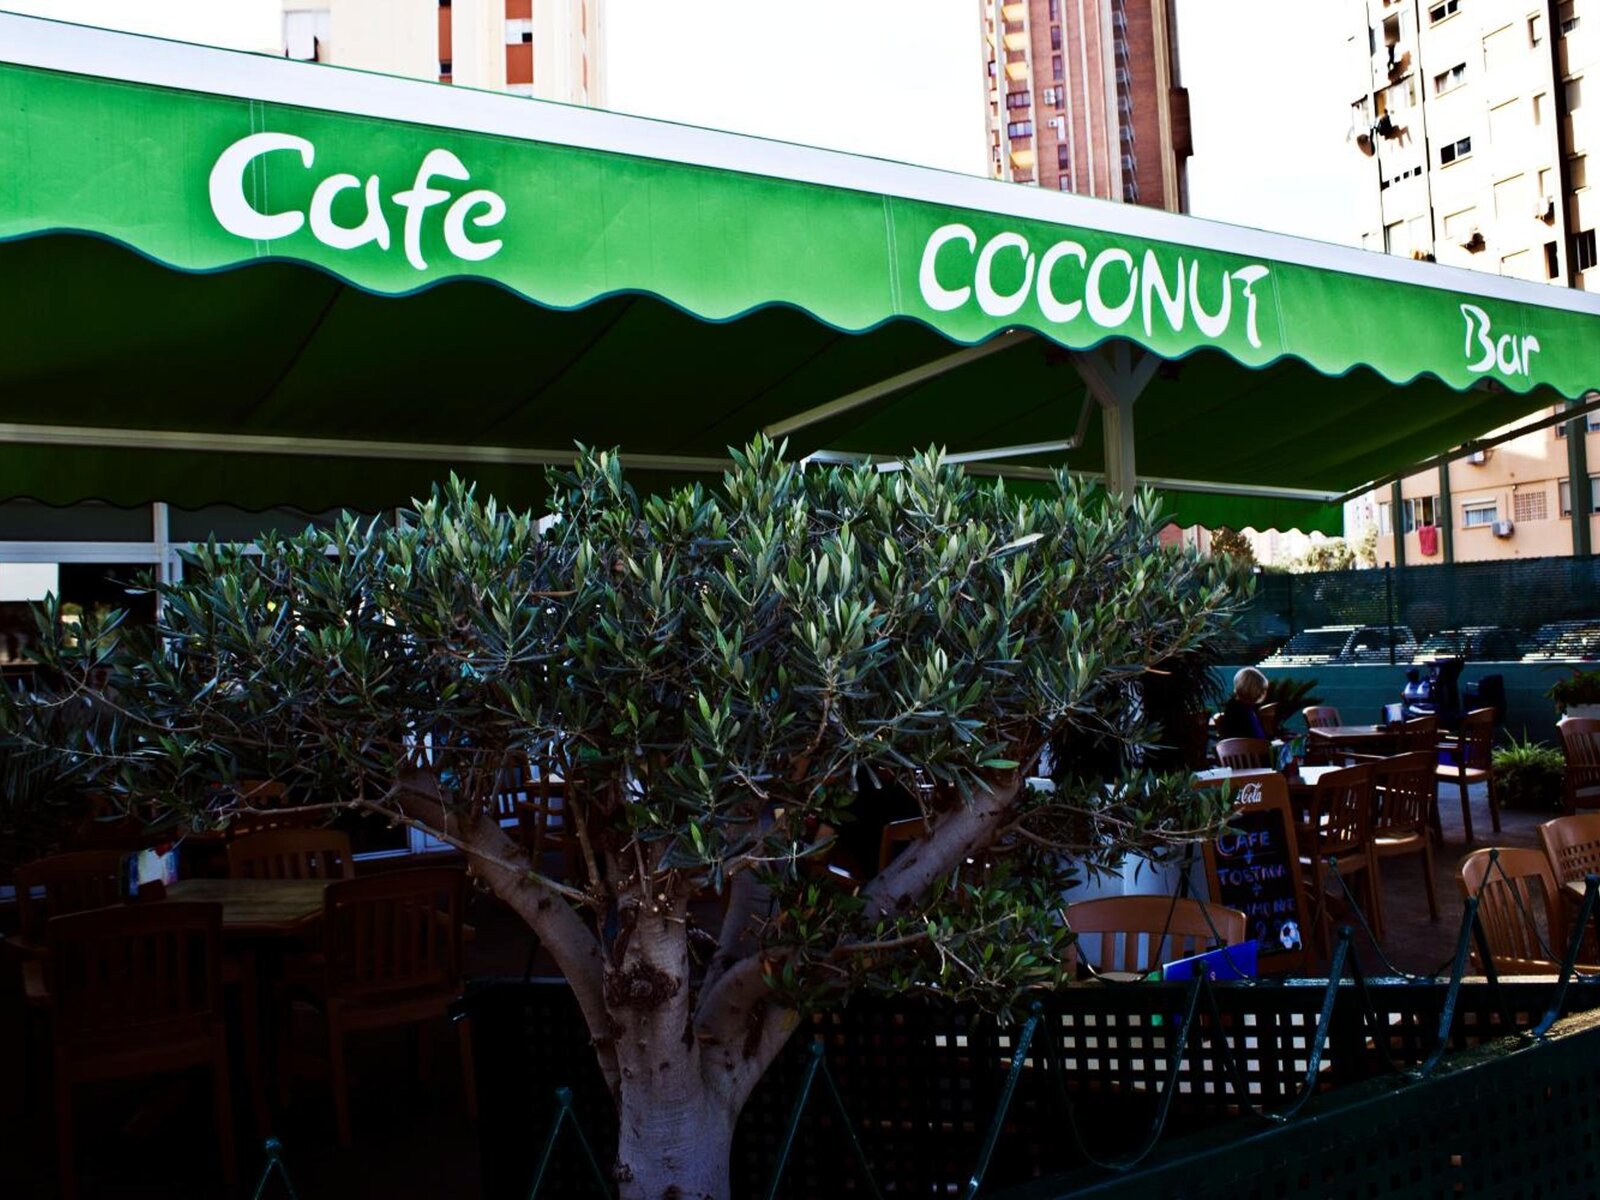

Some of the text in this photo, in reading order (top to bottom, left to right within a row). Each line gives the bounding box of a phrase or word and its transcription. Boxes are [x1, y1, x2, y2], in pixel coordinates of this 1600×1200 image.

[208, 131, 1541, 377] Cafe COCONUT Bar
[1216, 830, 1271, 857] CAFE
